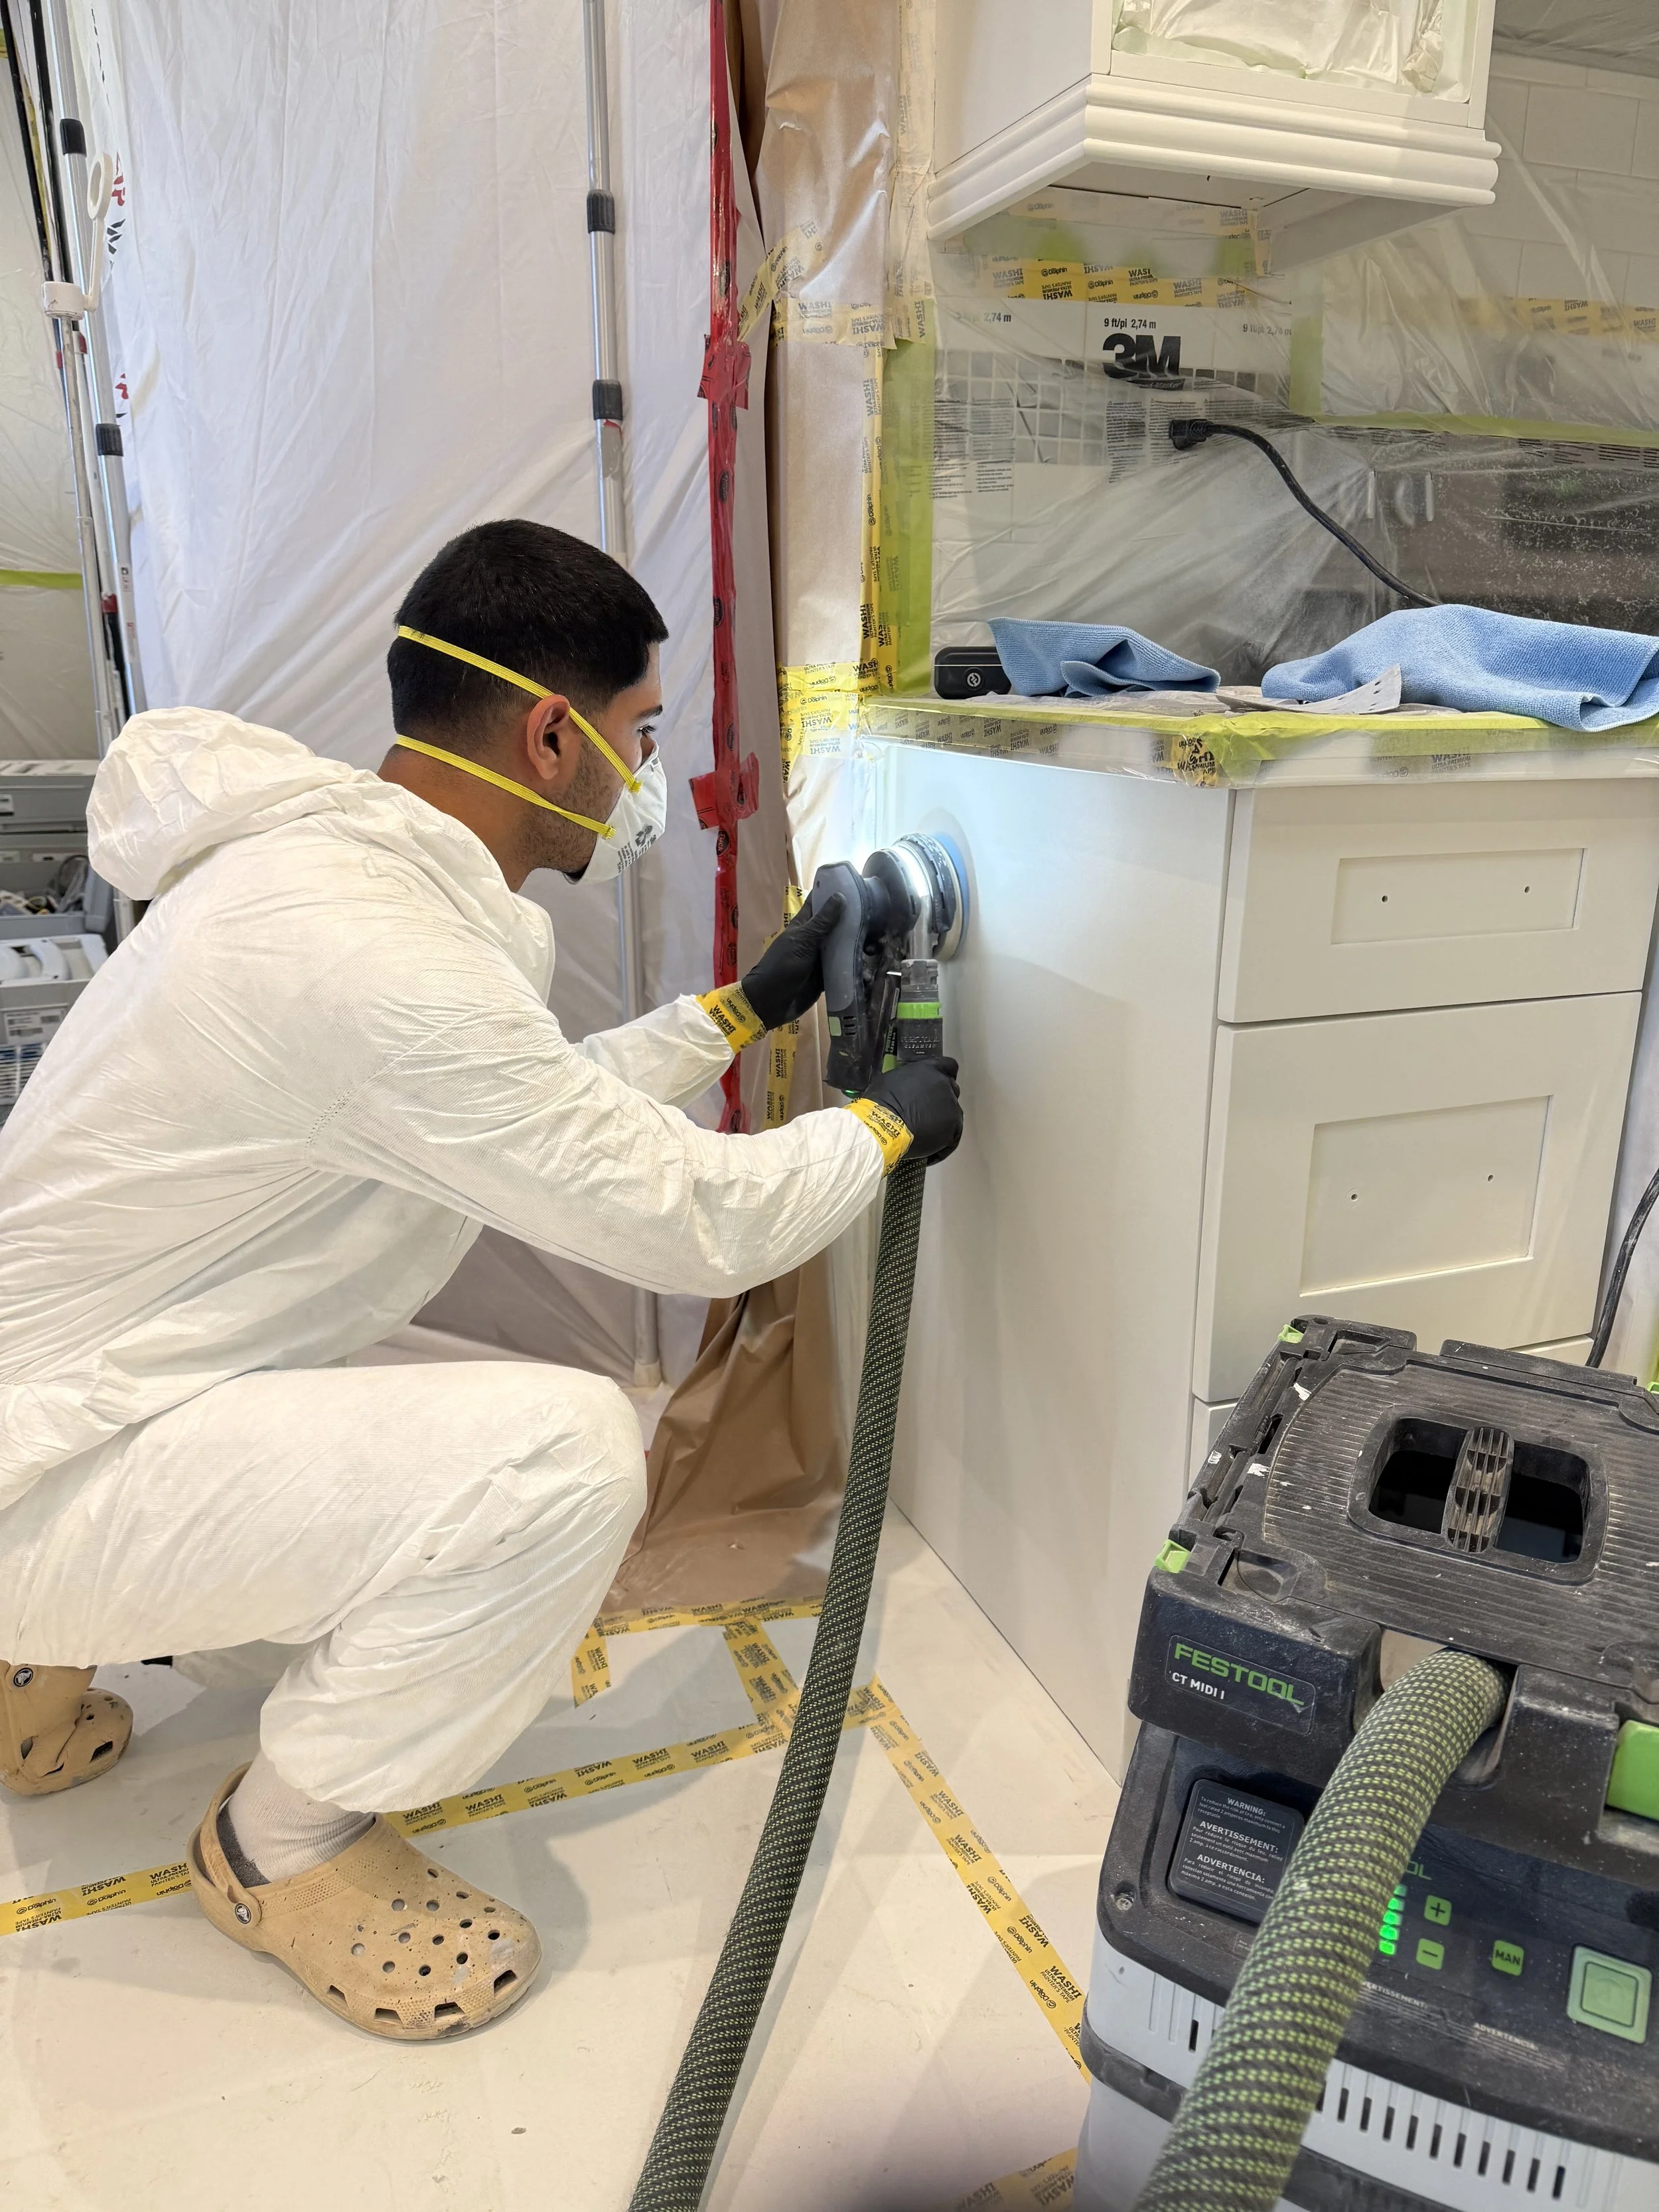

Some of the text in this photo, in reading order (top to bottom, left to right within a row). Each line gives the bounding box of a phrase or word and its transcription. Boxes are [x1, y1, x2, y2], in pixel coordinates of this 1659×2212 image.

[1220, 209, 1248, 220] WASHI
[993, 268, 1023, 279] WASHI
[1049, 267, 1067, 275] Dolphin
[1174, 277, 1202, 289] WASHI
[1043, 290, 1072, 300] WASHI
[798, 301, 832, 311] WASHI
[914, 301, 926, 338] WASHI
[1003, 313, 1011, 322] m
[1104, 318, 1110, 327] 9
[1112, 317, 1127, 329] ft/pi
[1131, 319, 1148, 330] 2,74
[852, 325, 884, 334] WASHI
[1102, 332, 1181, 379] 3M
[863, 380, 874, 417] WASHI
[860, 604, 870, 639] WASHI
[802, 717, 833, 728] WASHI
[984, 725, 1001, 737] WASHI
[916, 730, 930, 740] WASHI
[936, 732, 952, 743] WASHI
[810, 745, 841, 755] WASHI
[1011, 741, 1029, 751] WASHI
[1039, 743, 1059, 755] WASHI
[717, 832, 728, 852] Tuck
[713, 1005, 736, 1033] WASHI
[871, 1111, 901, 1136] WASHI
[595, 1647, 608, 1668] WASHI
[1175, 1643, 1305, 1706] FESTOOL
[1172, 1672, 1187, 1684] CT
[1190, 1679, 1218, 1696] MIDI
[632, 1748, 667, 1765] WASHI
[691, 1741, 726, 1757] WASHI
[577, 1761, 612, 1777] WASHI
[915, 1752, 939, 1777] WASHI
[402, 1802, 441, 1819] WASHI
[465, 1794, 502, 1811] WASHI
[938, 1791, 964, 1816] WASHI
[1228, 1797, 1265, 1816] WARNING:
[1198, 1808, 1221, 1819] receptacle.
[1224, 1811, 1243, 1820] amperes
[1244, 1817, 1266, 1828] maximum
[1264, 1818, 1282, 1827] connect
[1200, 1821, 1278, 1853] AVERTISSEMENT:
[1232, 1840, 1246, 1848] risque
[955, 1834, 982, 1862] WASHI
[1191, 1832, 1215, 1844] seulement
[1246, 1852, 1268, 1862] maximum
[149, 1862, 187, 1880] WASH
[1197, 1854, 1265, 1883] ADVERTENCIA:
[1198, 1863, 1214, 1872] reducir
[1228, 1873, 1241, 1881] riesgo
[82, 1877, 126, 1896] WASHI
[1203, 1871, 1226, 1883] solamente
[1236, 1882, 1265, 1897] herramienta
[98, 1889, 126, 1903] Dolphin
[28, 1899, 56, 1911] Dolphin
[1019, 1917, 1050, 1948] WASHI
[1014, 1933, 1032, 1954] Dolphin
[1496, 1949, 1520, 1966] MAN
[1030, 1980, 1049, 2001] Dolphin
[1041, 1971, 1071, 2003] PAINTER'S TAPE
[1045, 1969, 1075, 2001] ULTRA-PREMIUM
[1050, 1966, 1082, 1998] WASHI
